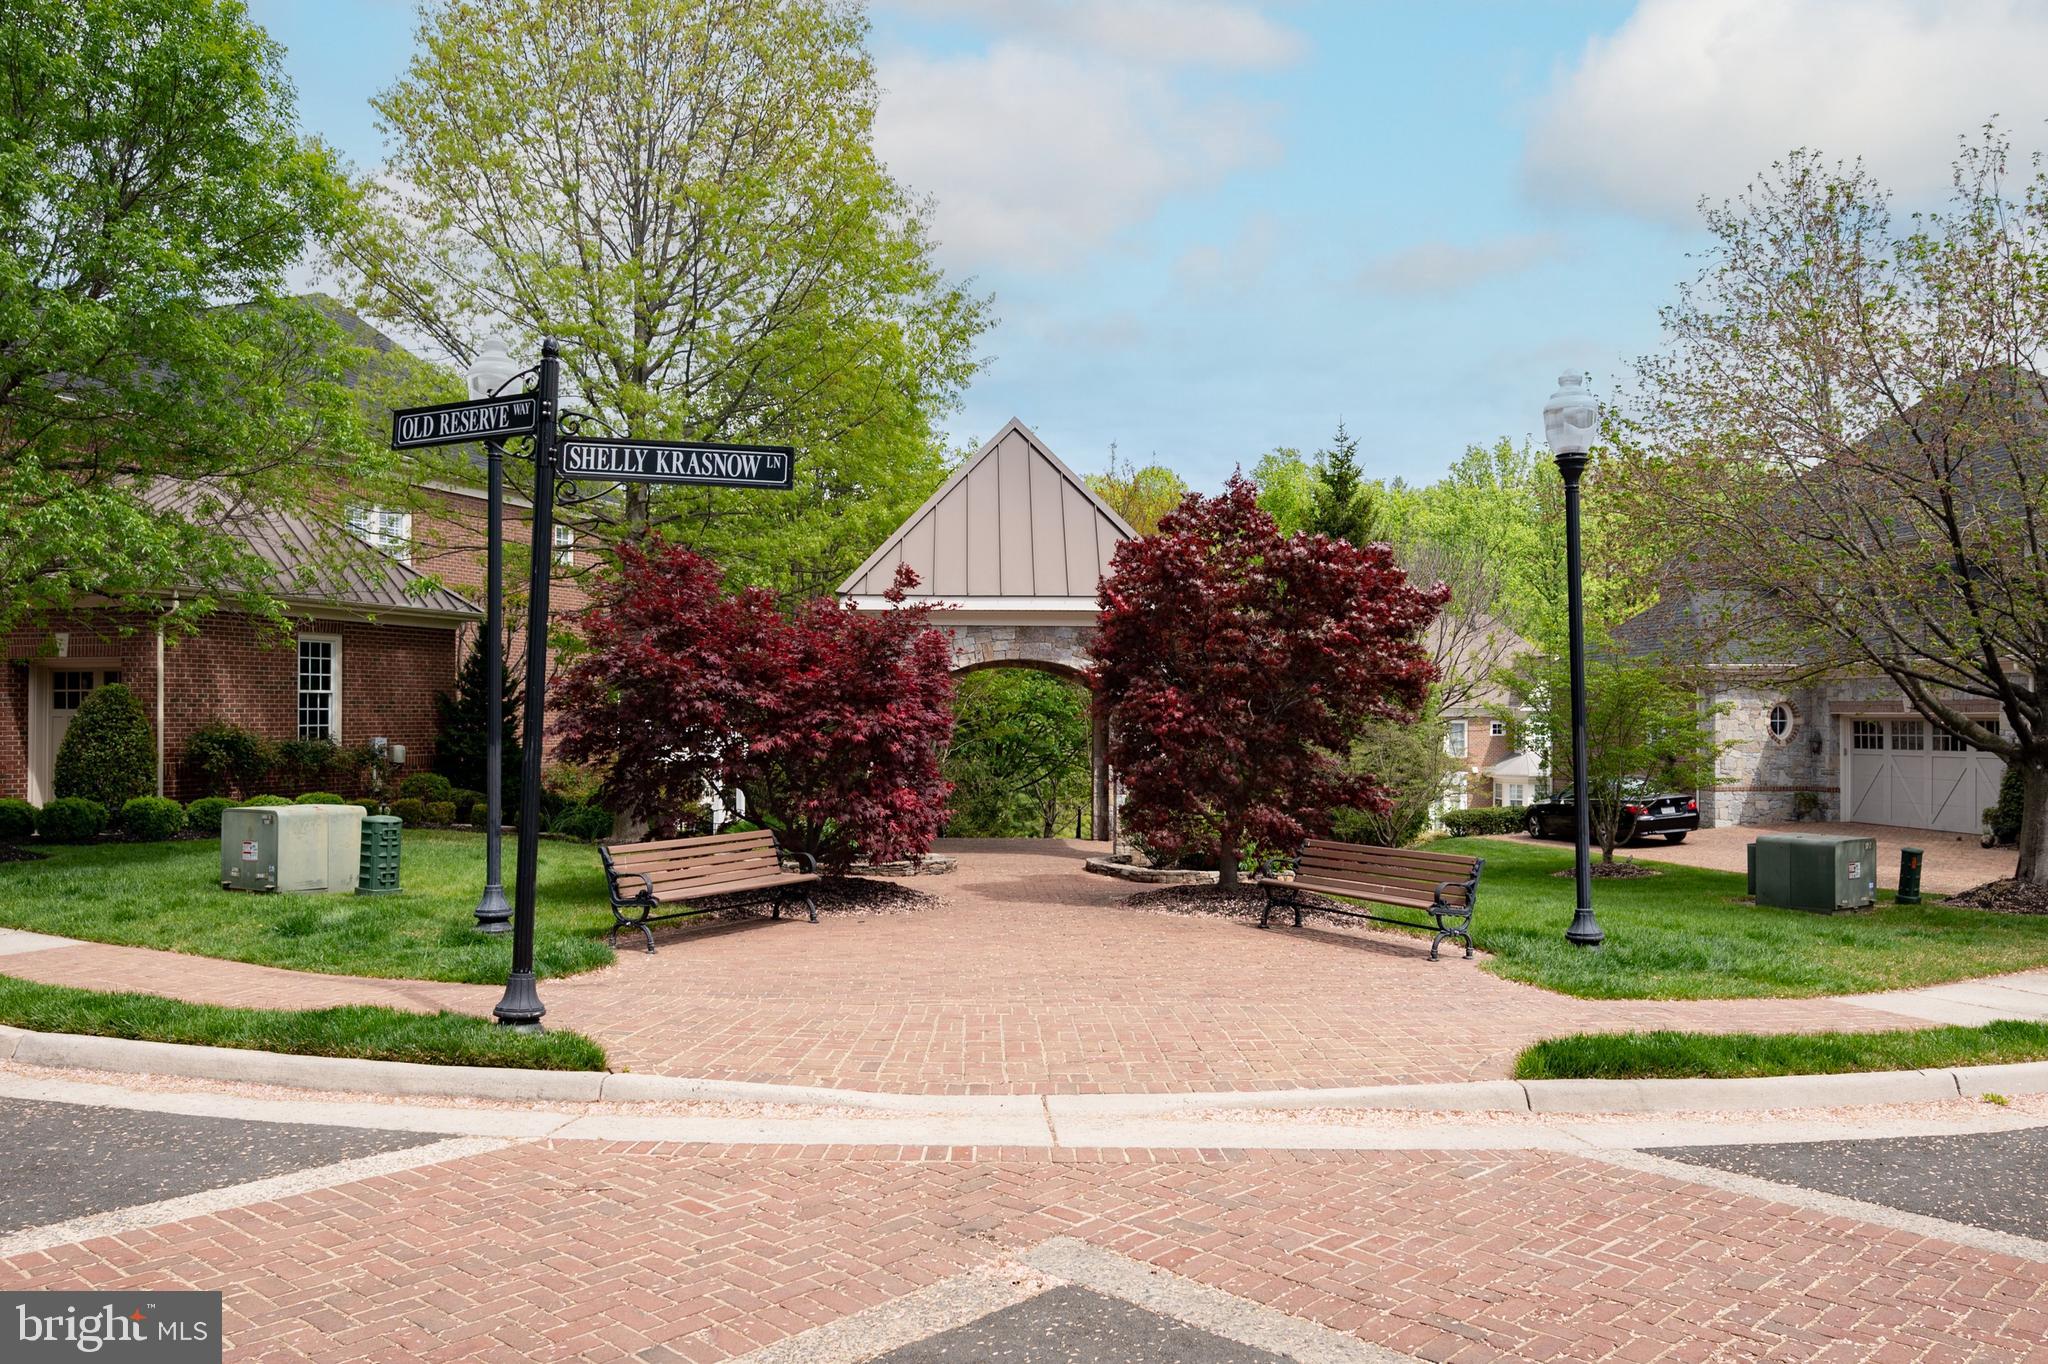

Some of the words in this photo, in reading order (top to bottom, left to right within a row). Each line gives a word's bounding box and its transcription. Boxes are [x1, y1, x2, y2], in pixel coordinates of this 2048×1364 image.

[402, 415, 434, 440] OLD
[440, 405, 510, 436] RESERVE
[513, 402, 532, 416] WAY
[569, 446, 649, 473] SHELLY
[656, 450, 762, 478] KRASNOW
[766, 456, 782, 469] LN
